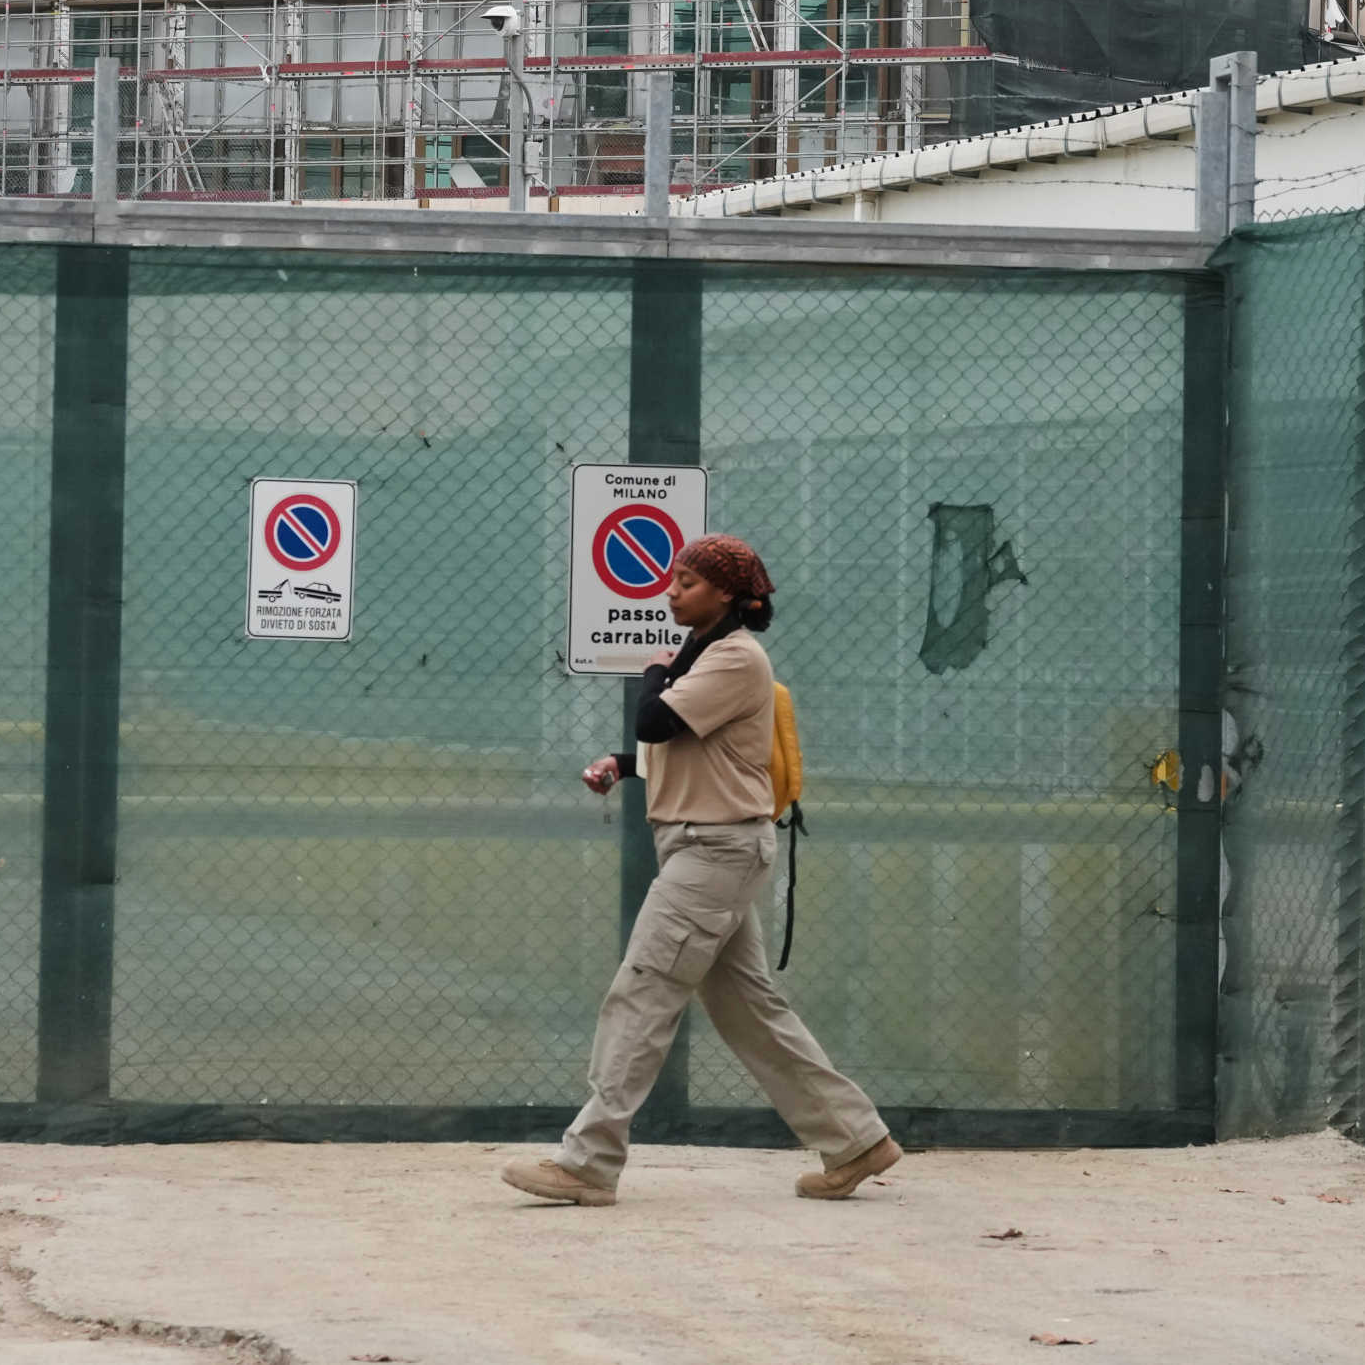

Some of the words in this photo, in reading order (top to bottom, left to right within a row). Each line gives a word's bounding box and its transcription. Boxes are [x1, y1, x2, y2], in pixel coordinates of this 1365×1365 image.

[605, 473, 659, 486] Comune
[663, 475, 676, 486] di
[613, 488, 667, 499] MILANO
[256, 606, 303, 617] RIMOZIONE
[304, 608, 342, 618] FORZATA
[608, 608, 667, 623] passo
[261, 619, 295, 630] DIVIETO
[297, 620, 306, 630] DI
[308, 620, 336, 631] SOSTA
[591, 629, 682, 645] carrabile
